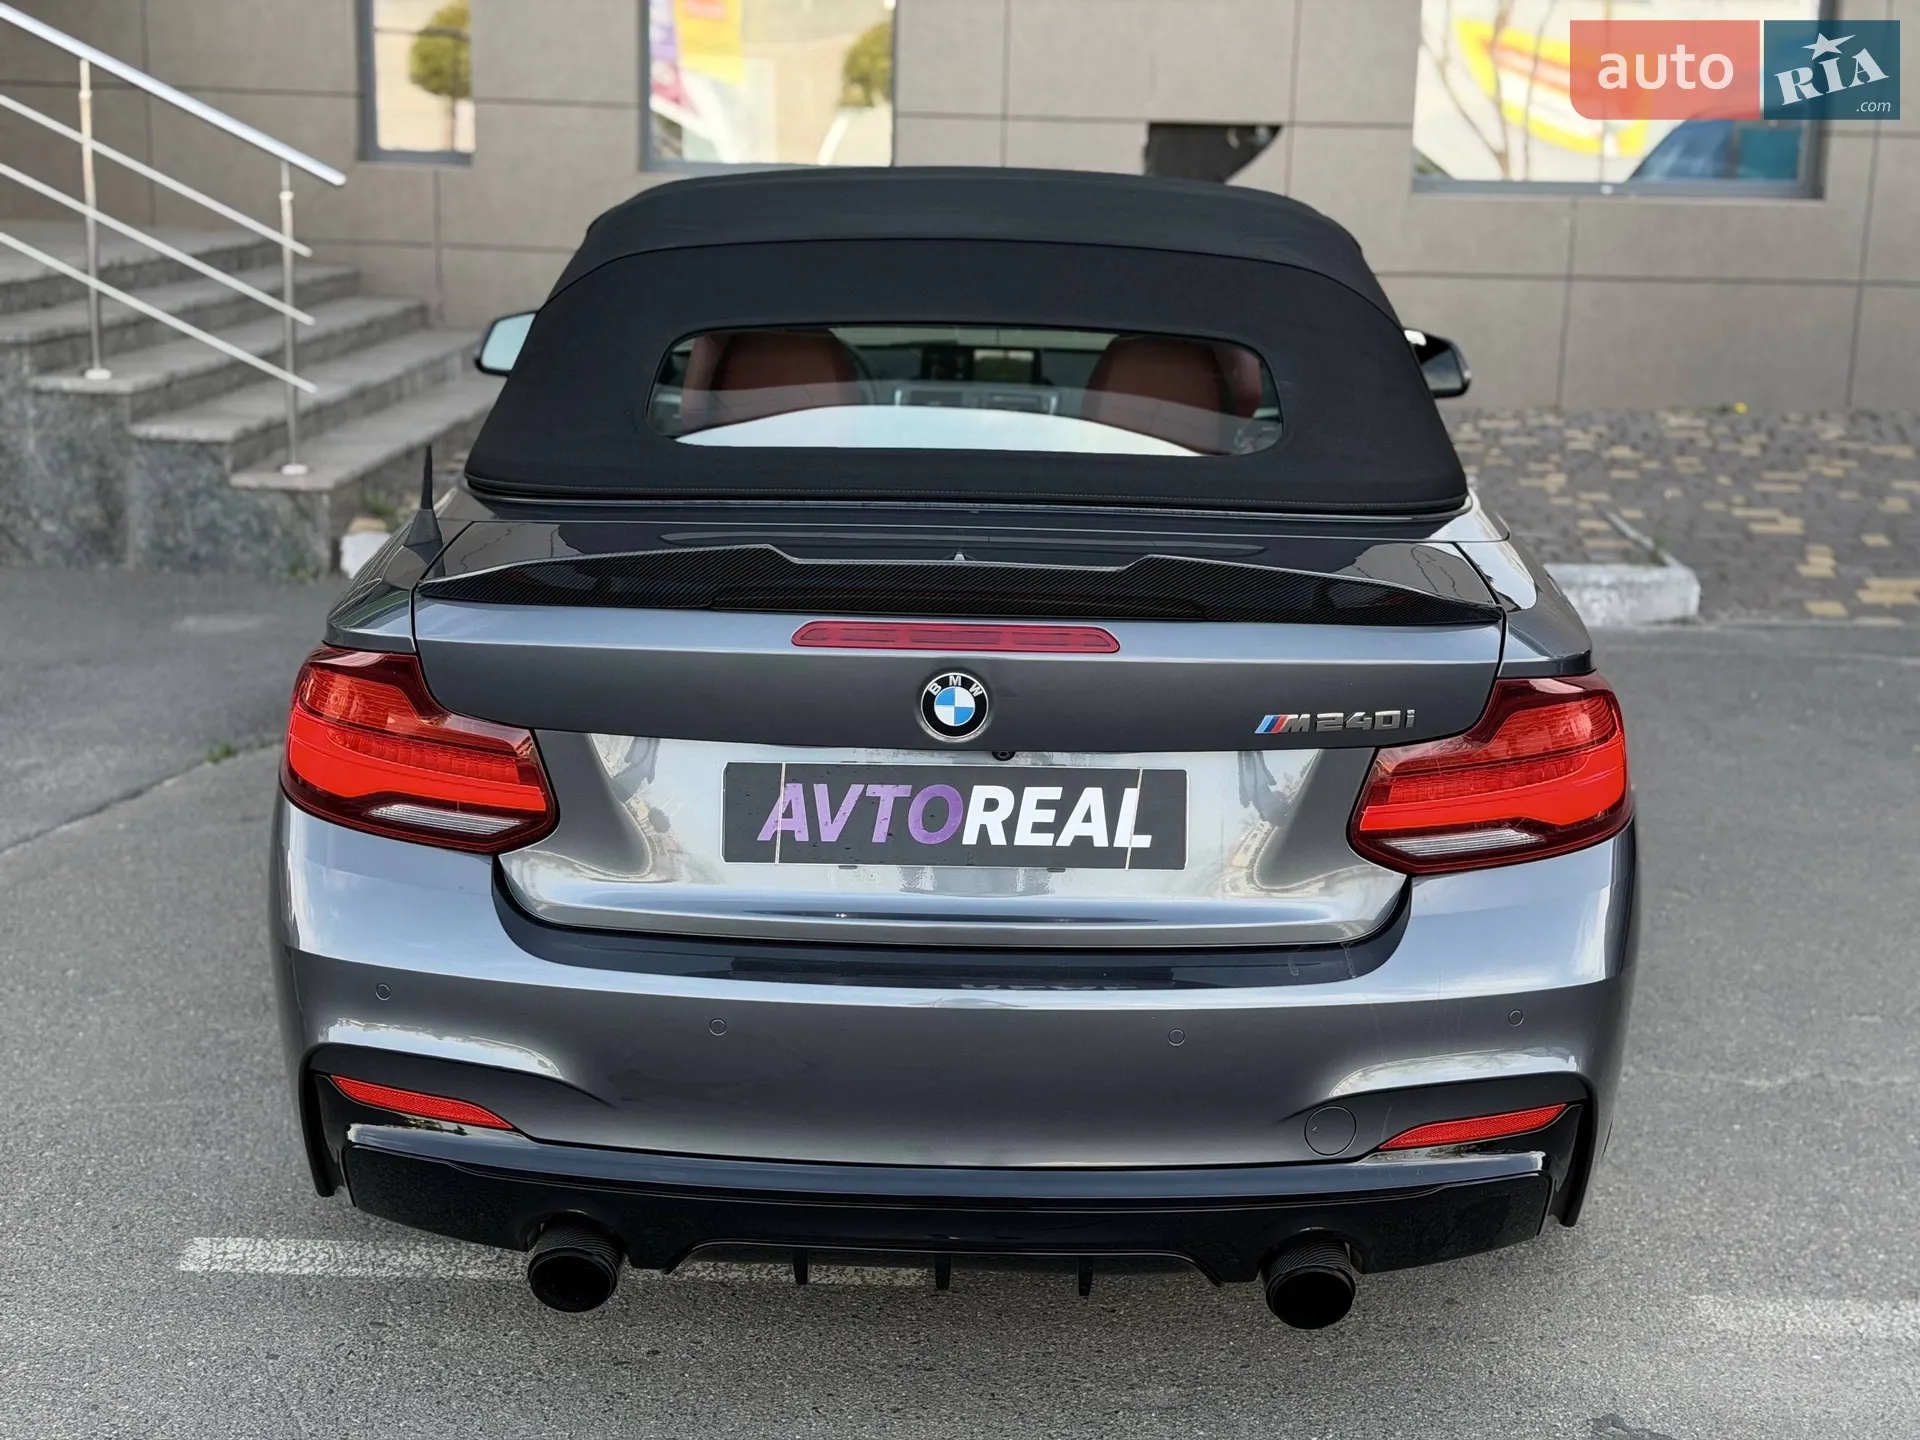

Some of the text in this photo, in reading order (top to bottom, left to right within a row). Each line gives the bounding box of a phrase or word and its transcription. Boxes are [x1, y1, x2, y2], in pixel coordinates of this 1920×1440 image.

[928, 675, 983, 697] BMW
[1278, 709, 1416, 733] M240i
[757, 783, 1152, 848] AVTOREAL
